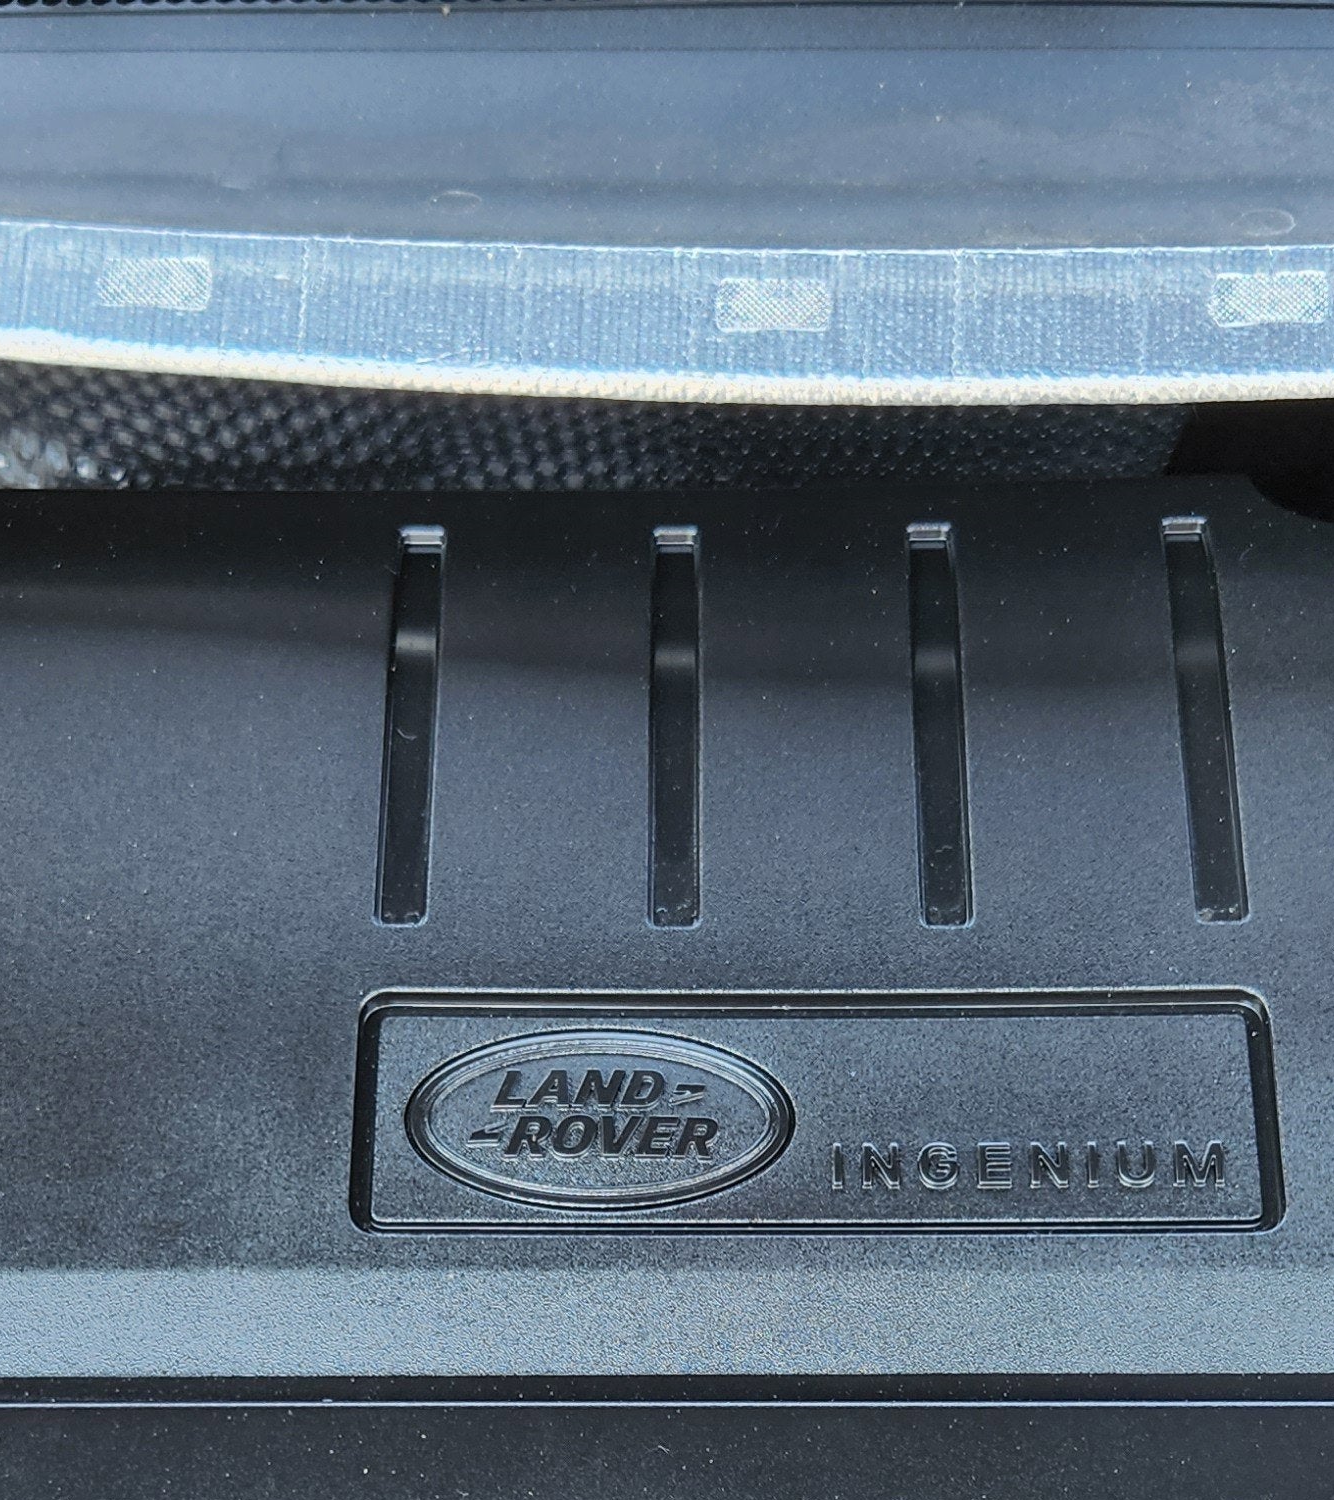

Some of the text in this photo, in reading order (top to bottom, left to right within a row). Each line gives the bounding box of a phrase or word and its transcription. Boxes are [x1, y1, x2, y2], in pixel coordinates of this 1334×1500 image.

[490, 1069, 666, 1112] LAND
[503, 1115, 719, 1162] ROVER
[831, 1140, 1226, 1190] INGENIUM
